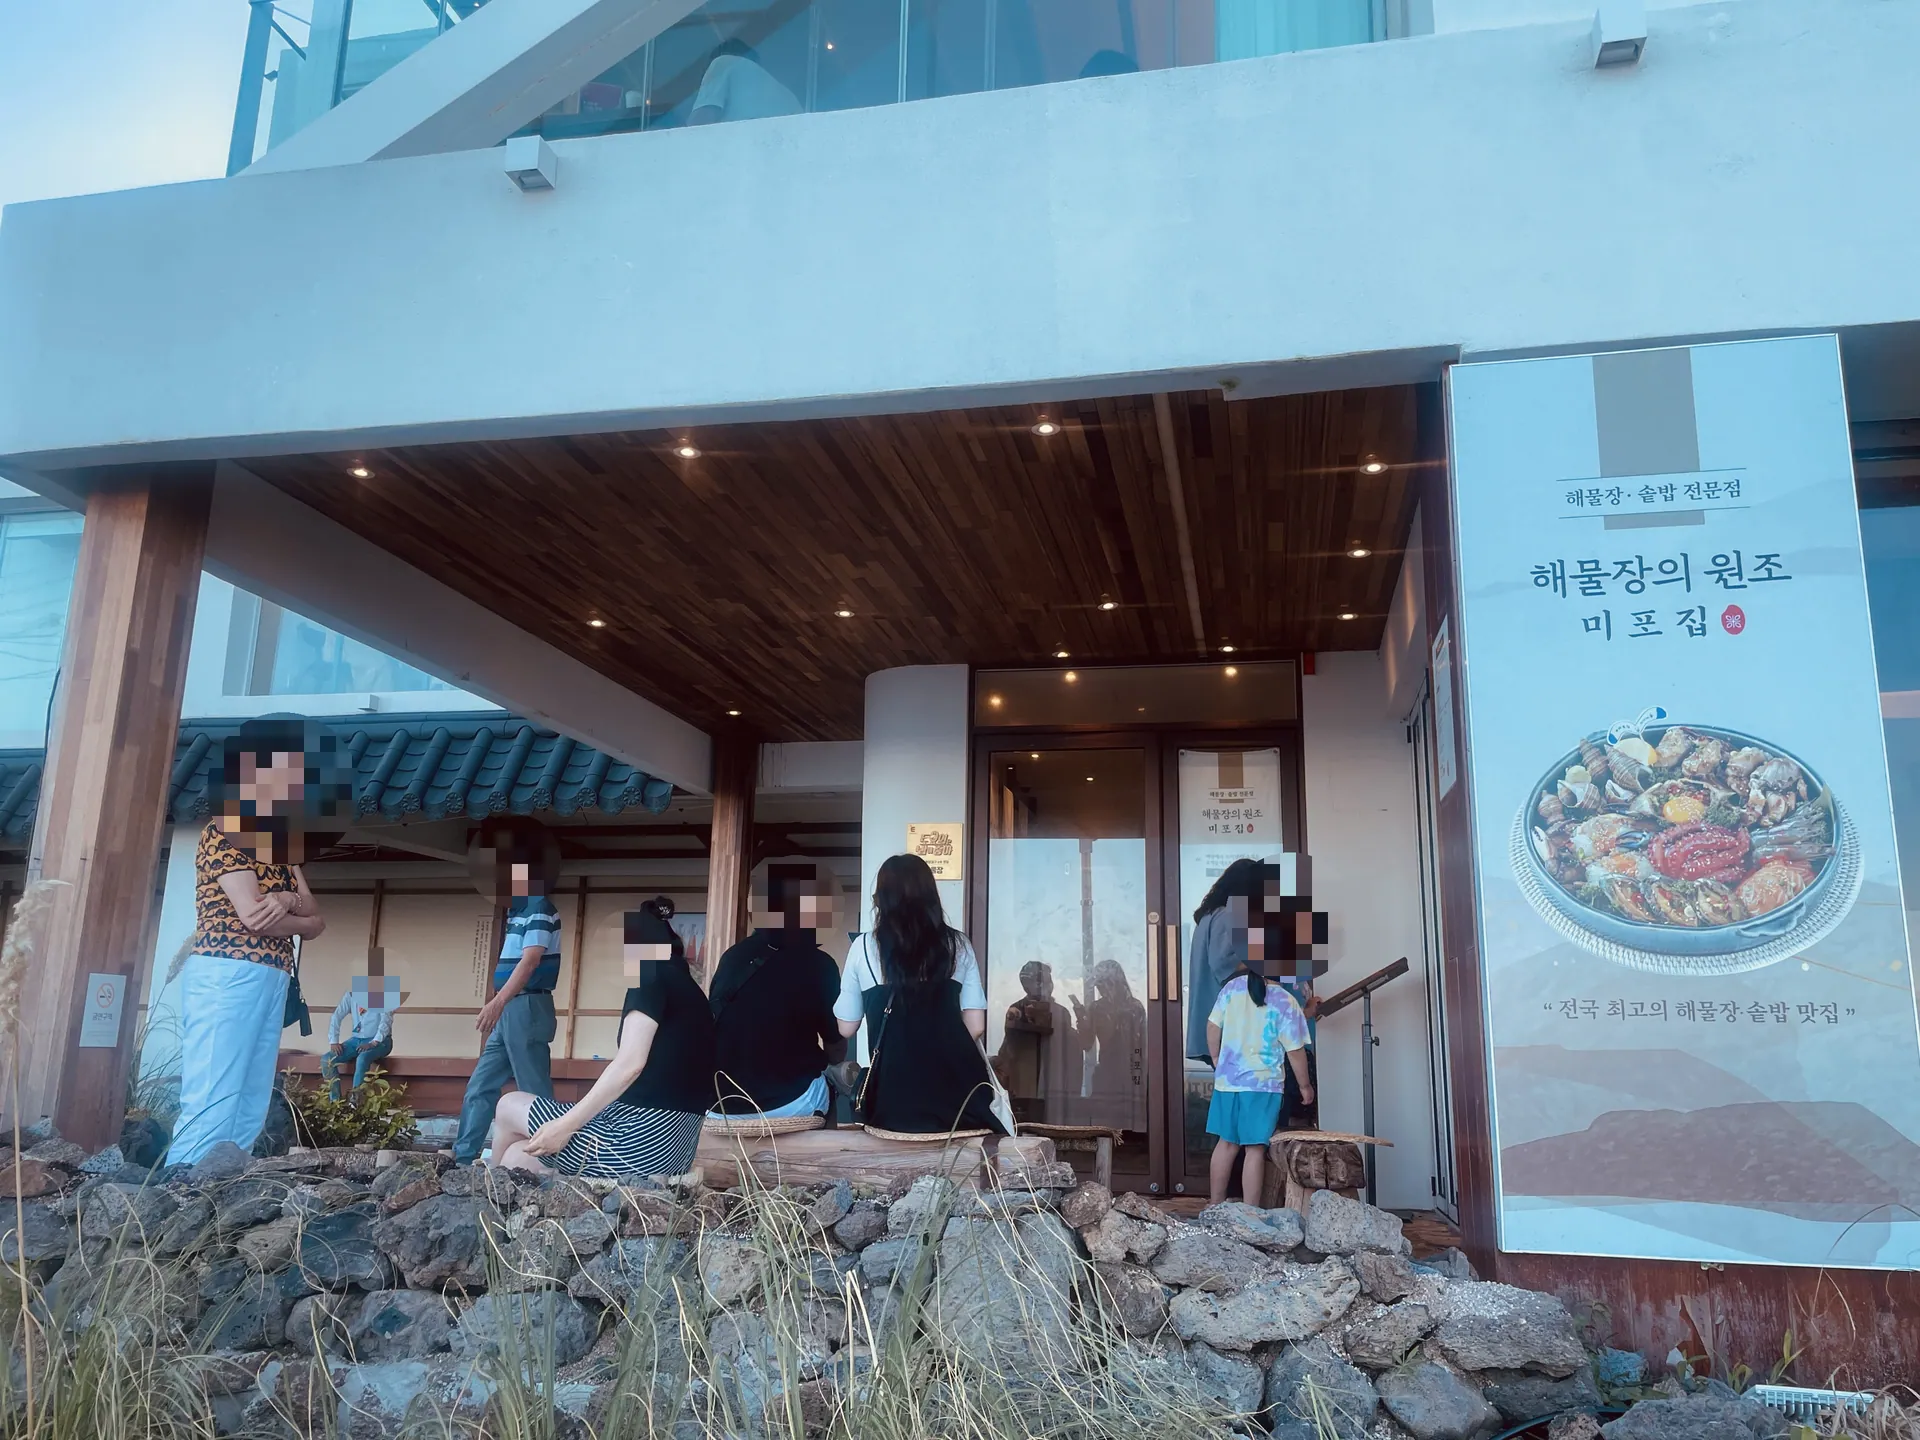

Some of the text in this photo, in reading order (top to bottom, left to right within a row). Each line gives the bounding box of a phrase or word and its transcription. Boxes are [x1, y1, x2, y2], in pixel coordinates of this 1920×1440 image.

[1683, 478, 1742, 501] 전문점
[1530, 549, 1793, 599] 해물장의 원조
[1202, 808, 1263, 820] 해물장의 원조
[1606, 999, 1668, 1022] 최고의
